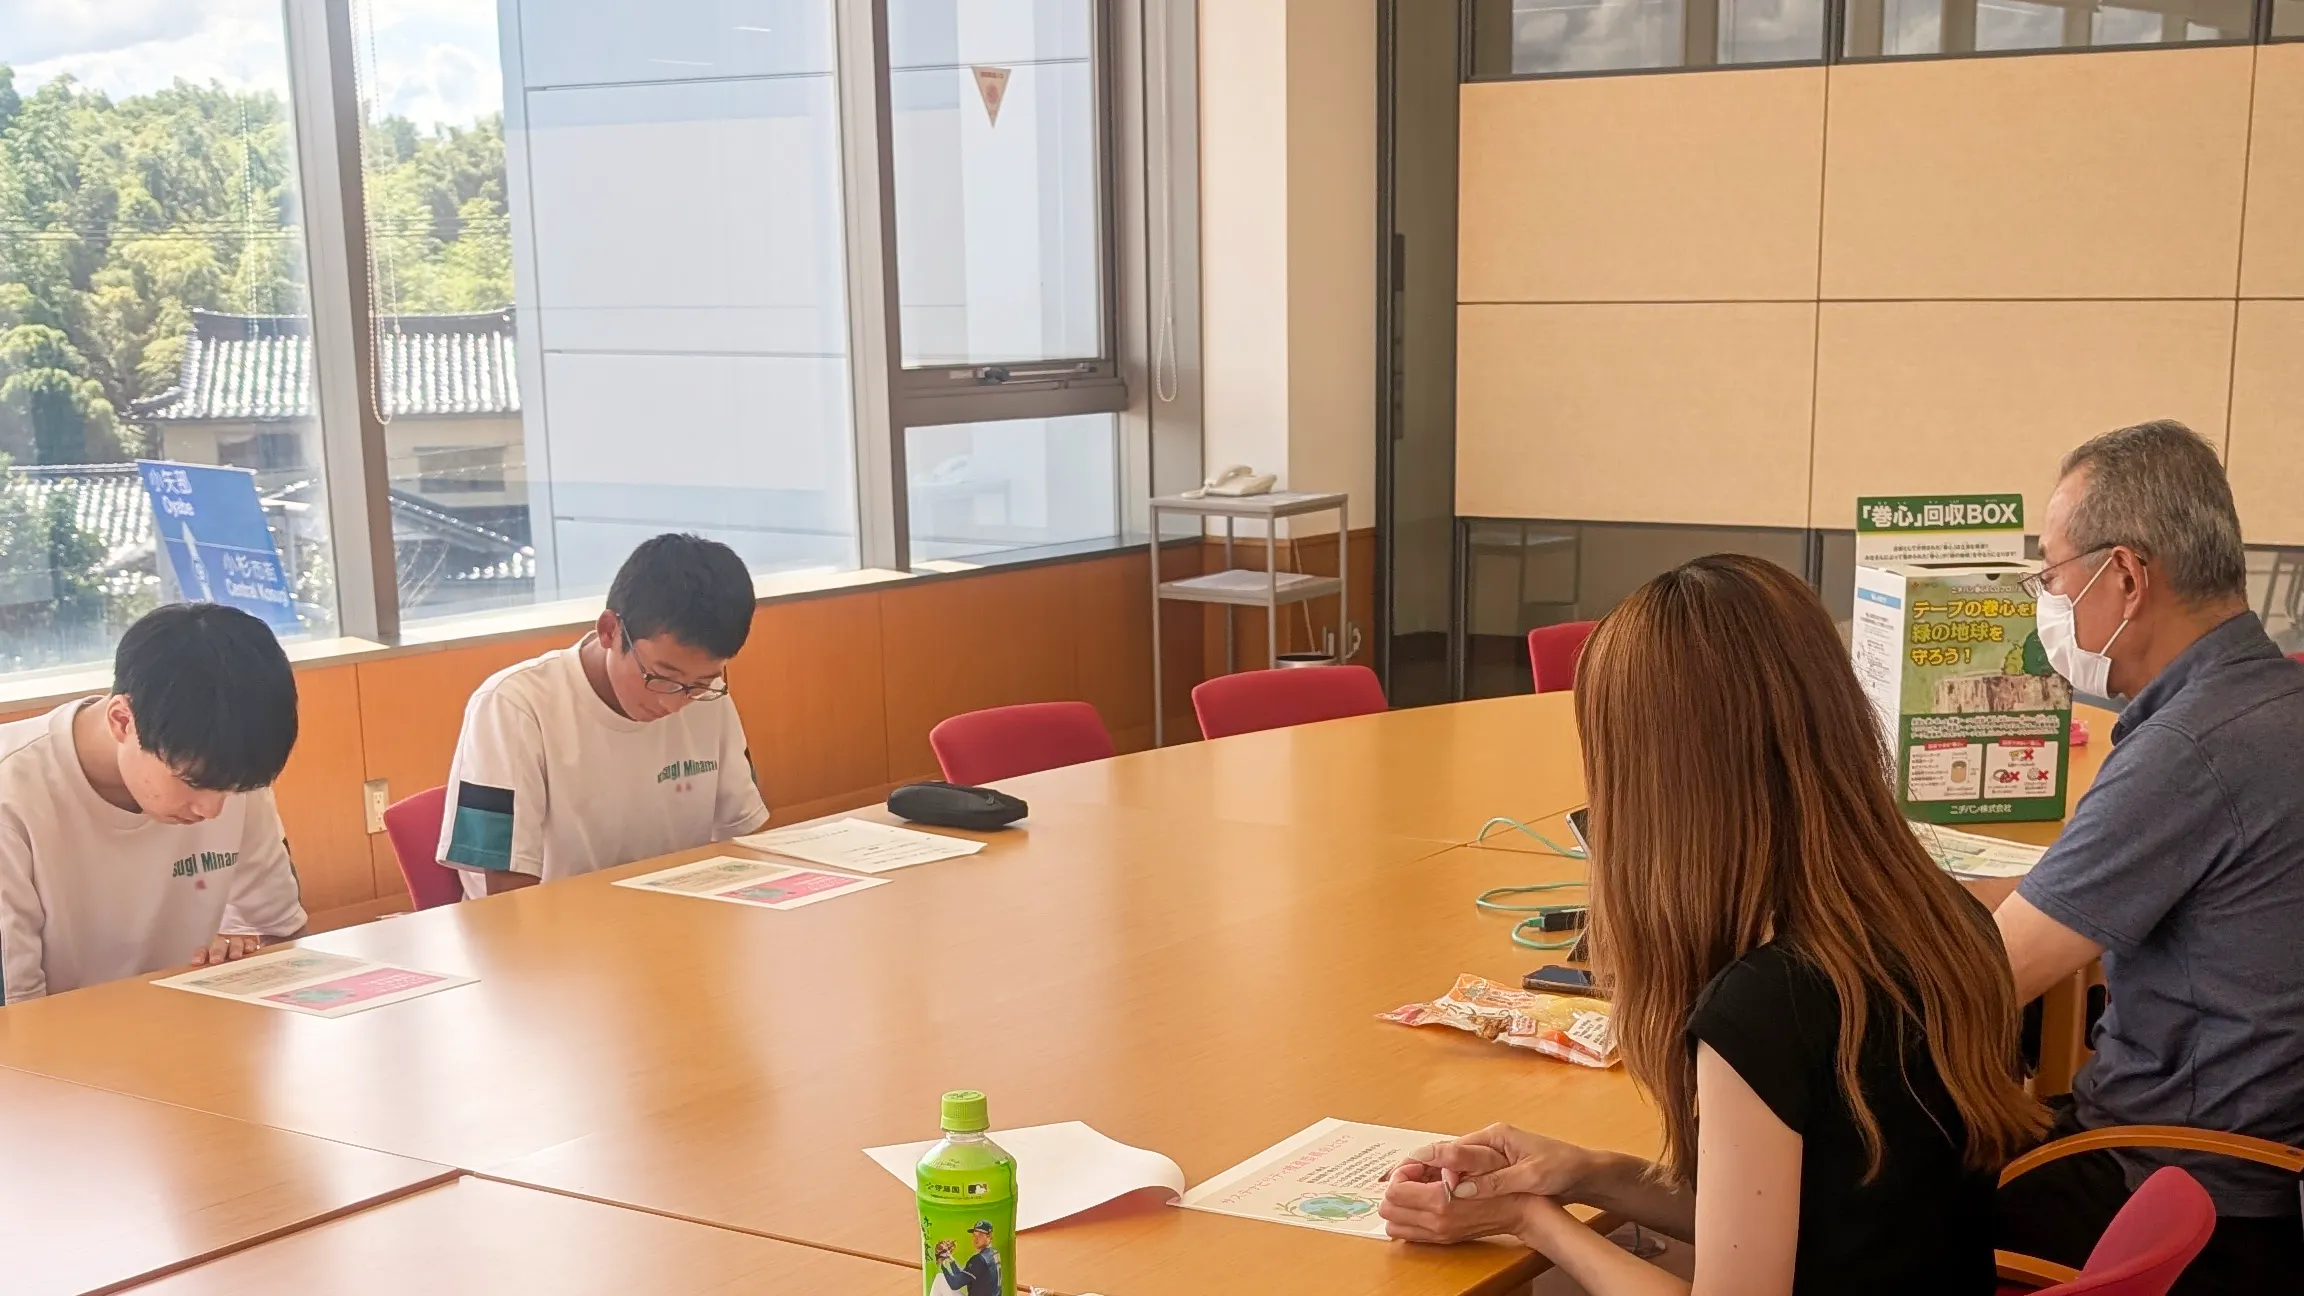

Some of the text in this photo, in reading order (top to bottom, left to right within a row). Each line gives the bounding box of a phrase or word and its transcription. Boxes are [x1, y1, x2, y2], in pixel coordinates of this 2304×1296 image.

[148, 468, 193, 495] 小矢部
[1862, 503, 2018, 528] 「巻心」回収BOX
[1912, 598, 2037, 619] テープの巻心を
[1910, 621, 2004, 644] 緑の地球を
[1910, 647, 1971, 666] 守ろう！
[683, 760, 717, 777] Minami
